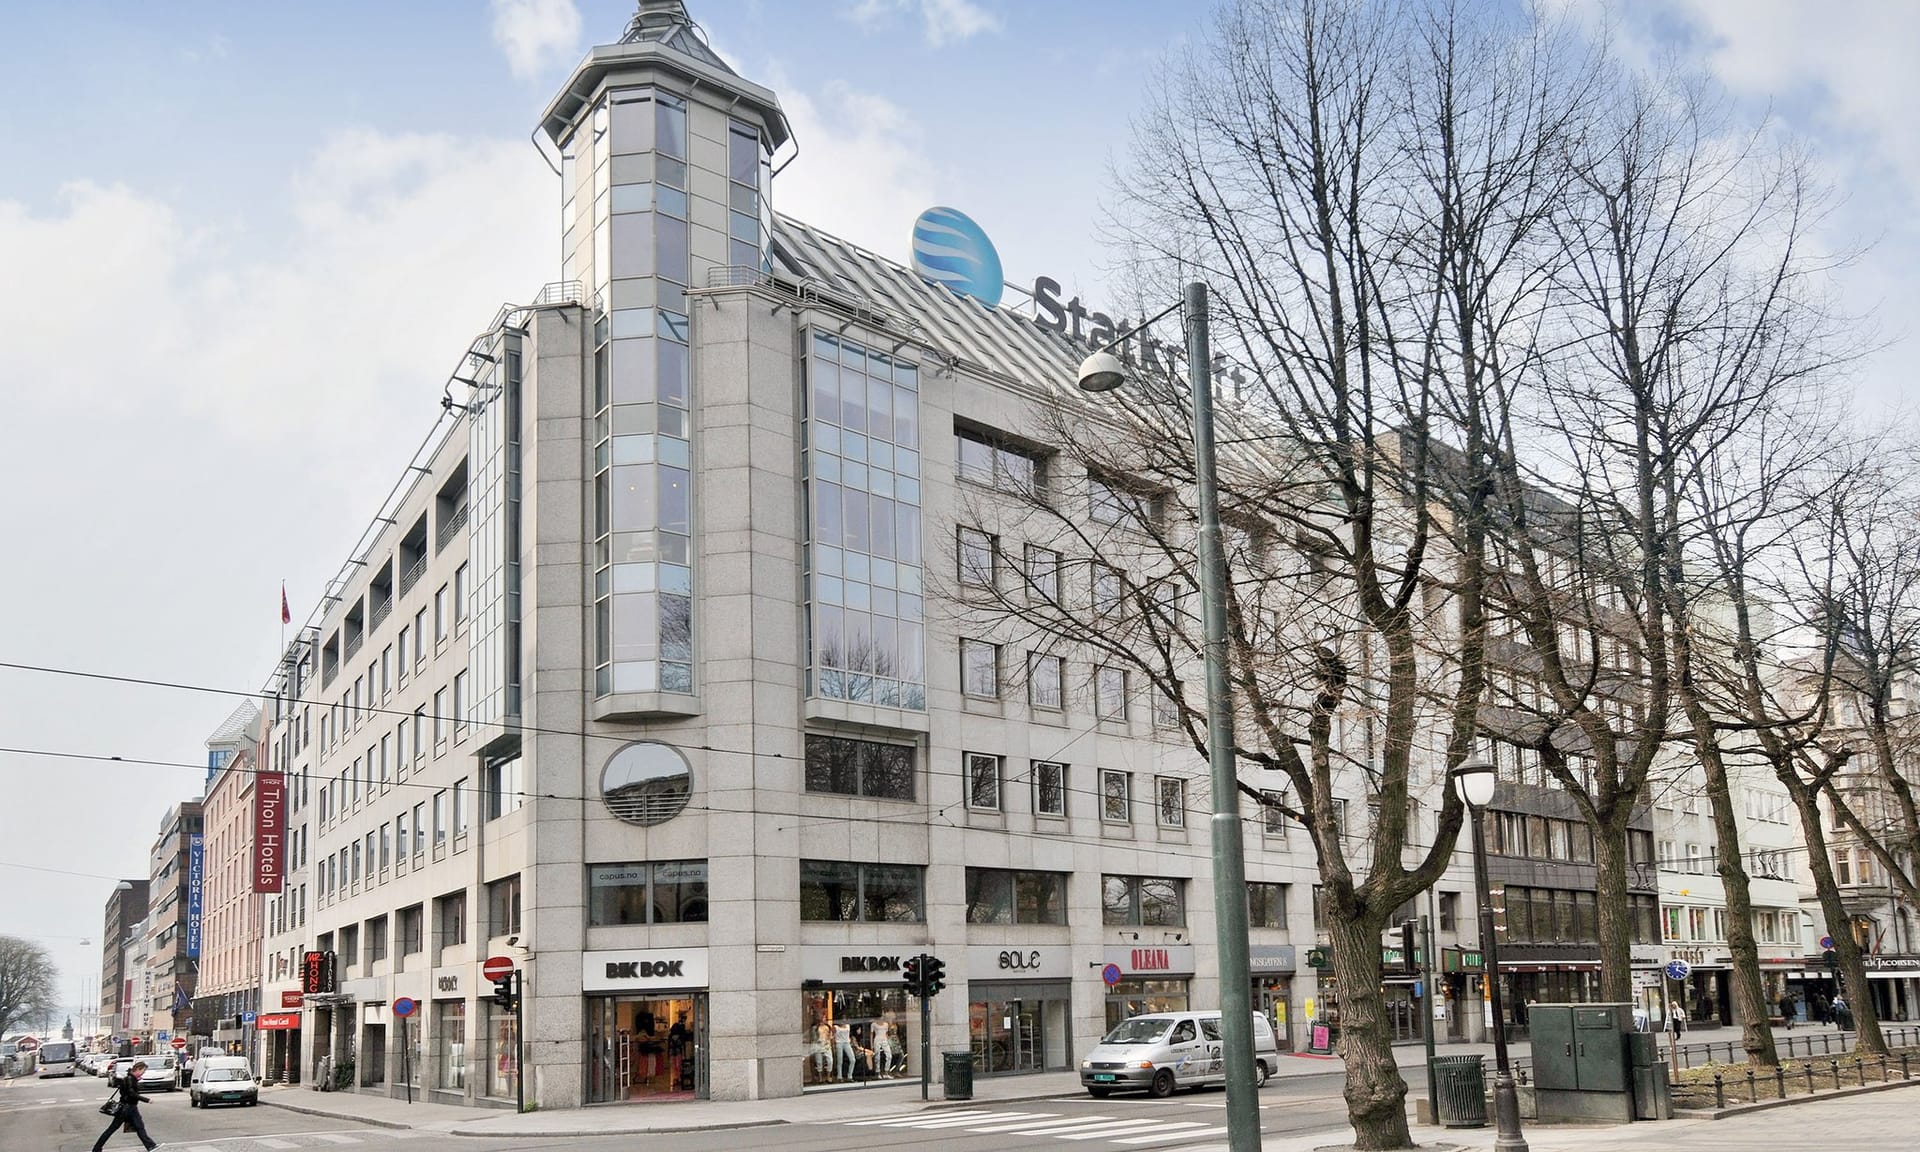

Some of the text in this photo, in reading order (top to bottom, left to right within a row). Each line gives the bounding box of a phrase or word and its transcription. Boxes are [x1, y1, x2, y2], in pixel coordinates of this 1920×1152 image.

[1034, 276, 1246, 401] Statkrft
[261, 789, 280, 885] Thon Hotels
[600, 871, 638, 881] capus.no
[191, 851, 201, 950] VICTORIA HOTEL
[606, 960, 684, 979] BIK BOK
[841, 956, 900, 972] BIK BOK
[999, 950, 1040, 969] SOLE
[1131, 949, 1169, 970] OLEANA
[309, 962, 319, 992] HONG
